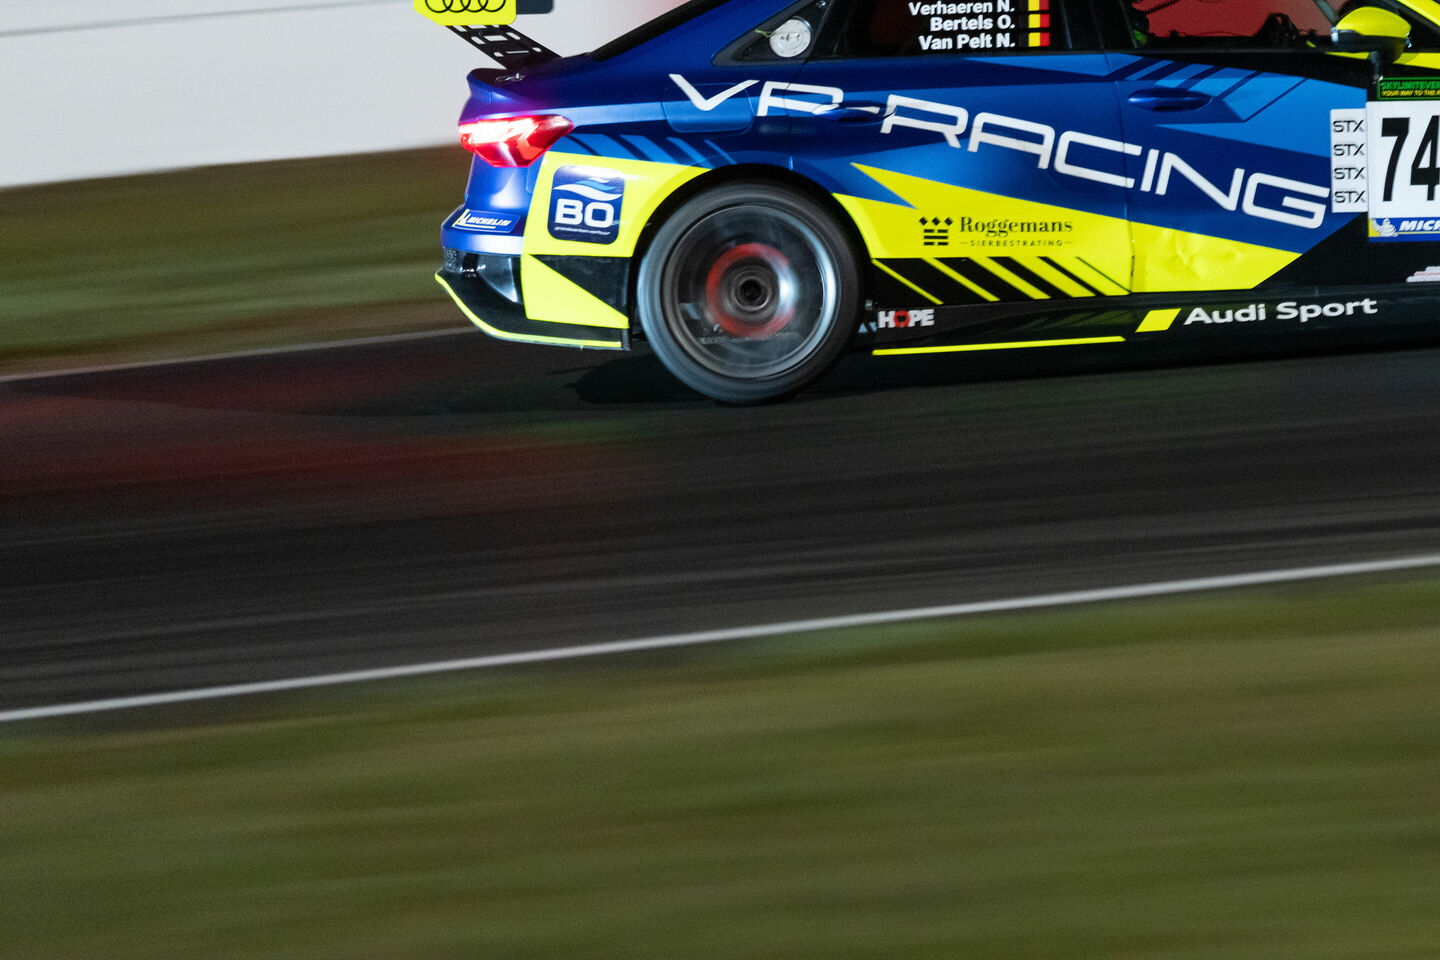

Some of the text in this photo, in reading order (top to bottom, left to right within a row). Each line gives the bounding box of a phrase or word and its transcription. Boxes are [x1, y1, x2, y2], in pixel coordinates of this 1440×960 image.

[908, 0, 993, 16] Verhaeren
[930, 14, 1016, 32] Bertels O.
[918, 32, 1016, 51] Van Pelt N.
[1332, 119, 1366, 133] STX
[1333, 143, 1366, 157] STX
[1333, 167, 1366, 180] STX
[1334, 190, 1367, 204] STX
[554, 198, 615, 229] BO
[960, 216, 1073, 238] Roggemans
[878, 308, 935, 329] HOPE
[1183, 297, 1379, 326] Audi Sport
